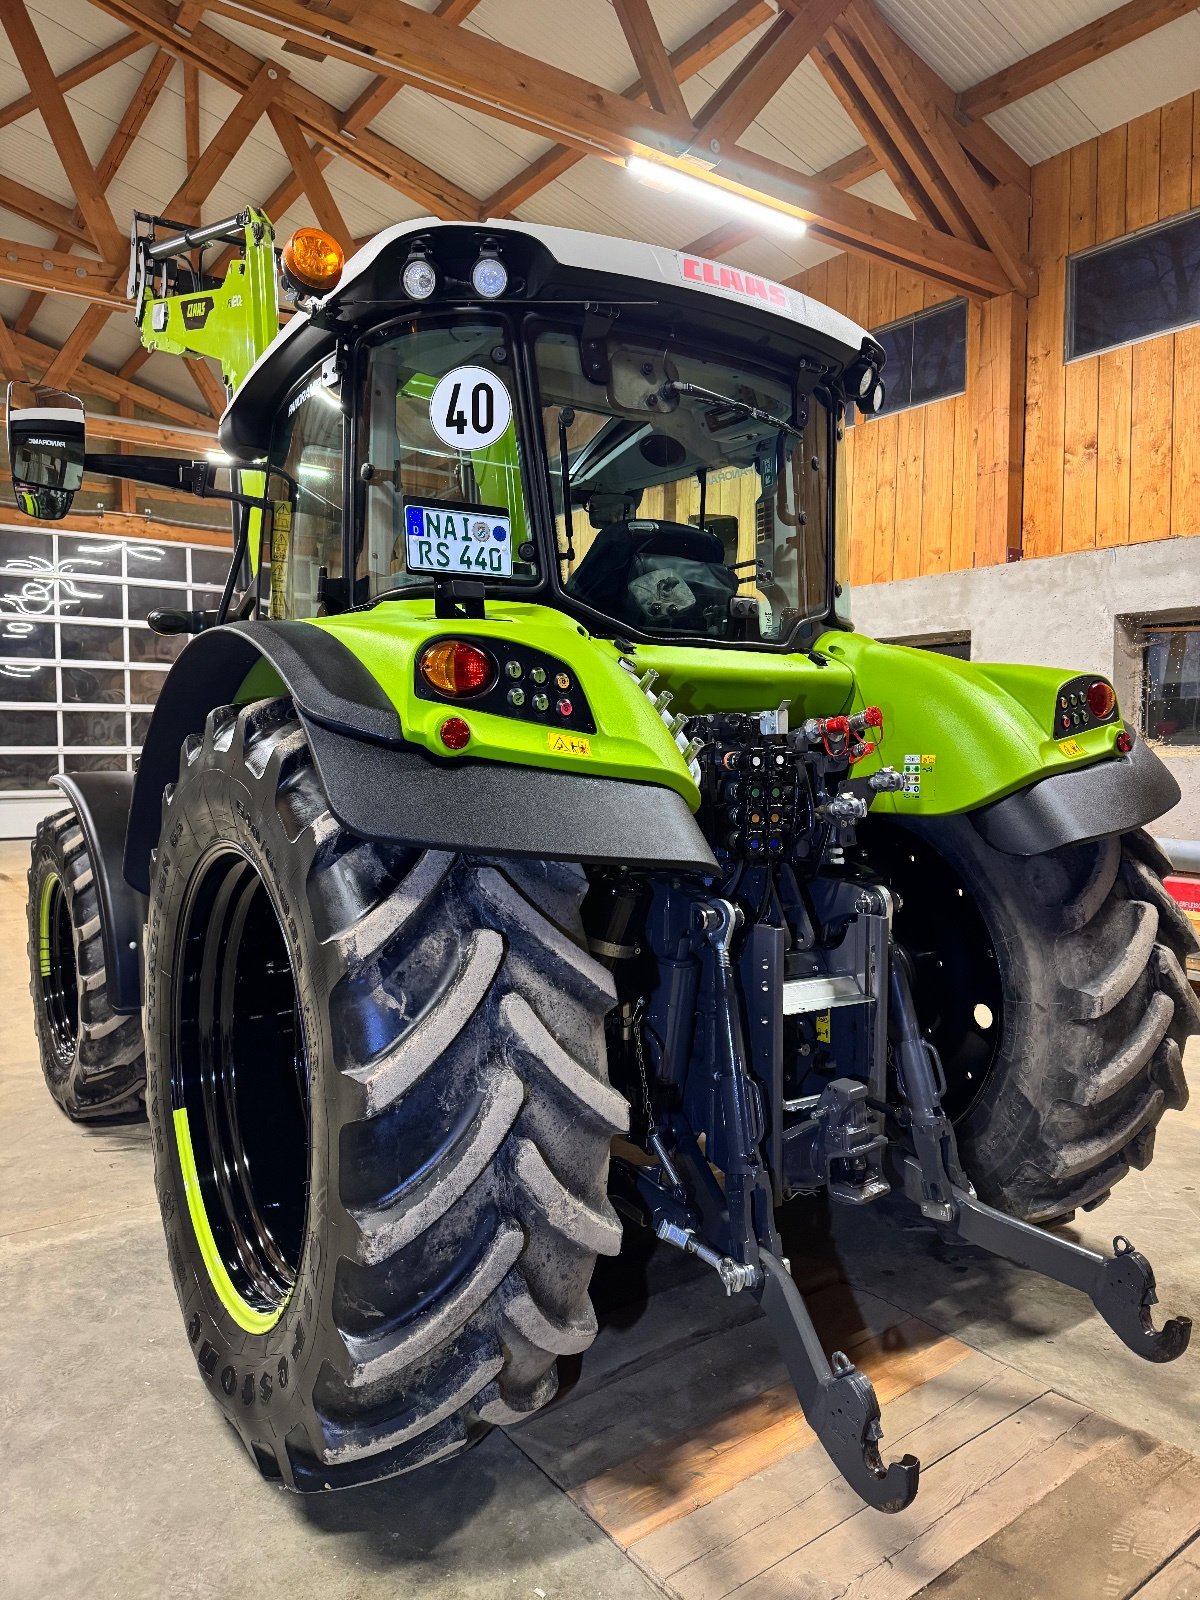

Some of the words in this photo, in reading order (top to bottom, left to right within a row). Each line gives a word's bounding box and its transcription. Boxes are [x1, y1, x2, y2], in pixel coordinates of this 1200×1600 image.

[683, 258, 787, 308] CLAAS
[186, 301, 206, 318] CLAAS
[445, 382, 495, 435] 40
[426, 512, 473, 542] NAI
[418, 540, 451, 567] RS
[459, 544, 503, 571] 440
